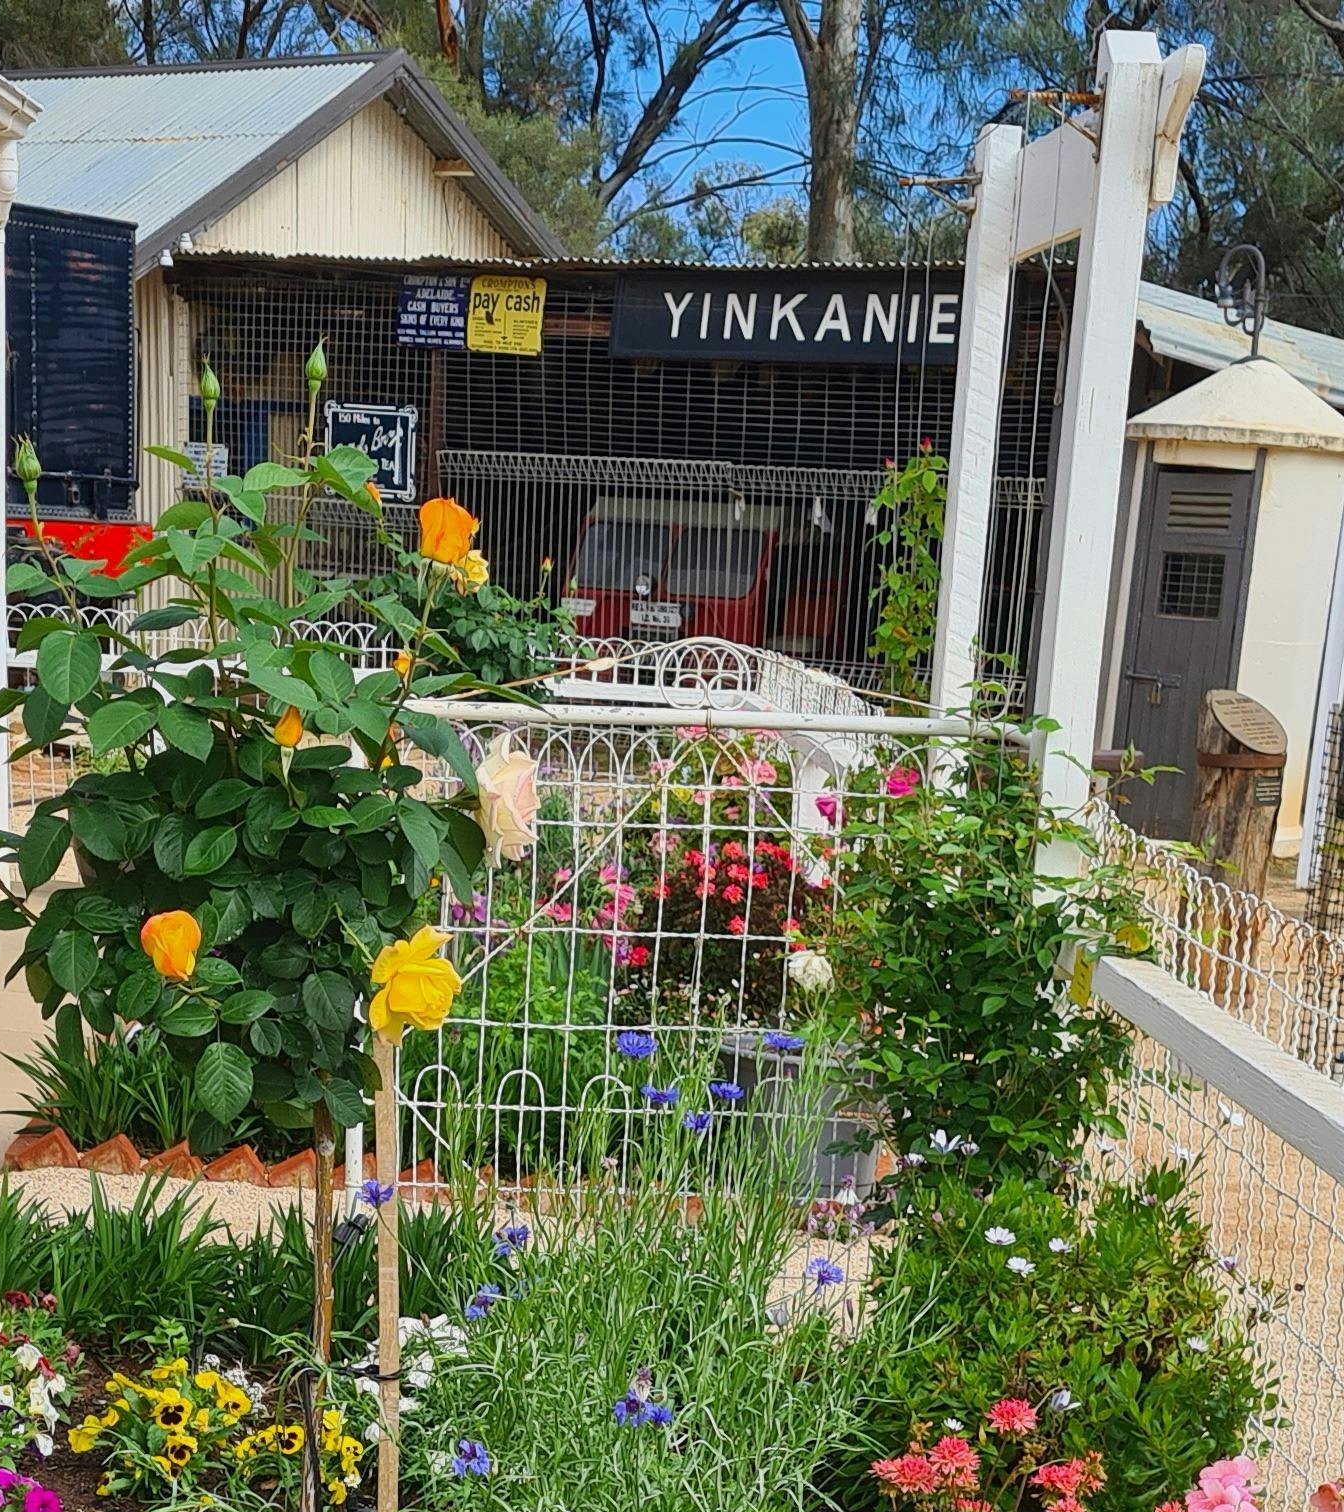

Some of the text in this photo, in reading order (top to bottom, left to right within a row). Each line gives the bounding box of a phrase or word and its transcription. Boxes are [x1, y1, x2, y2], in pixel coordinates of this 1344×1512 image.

[472, 290, 541, 316] pay cash
[663, 292, 960, 344] YINKANIE
